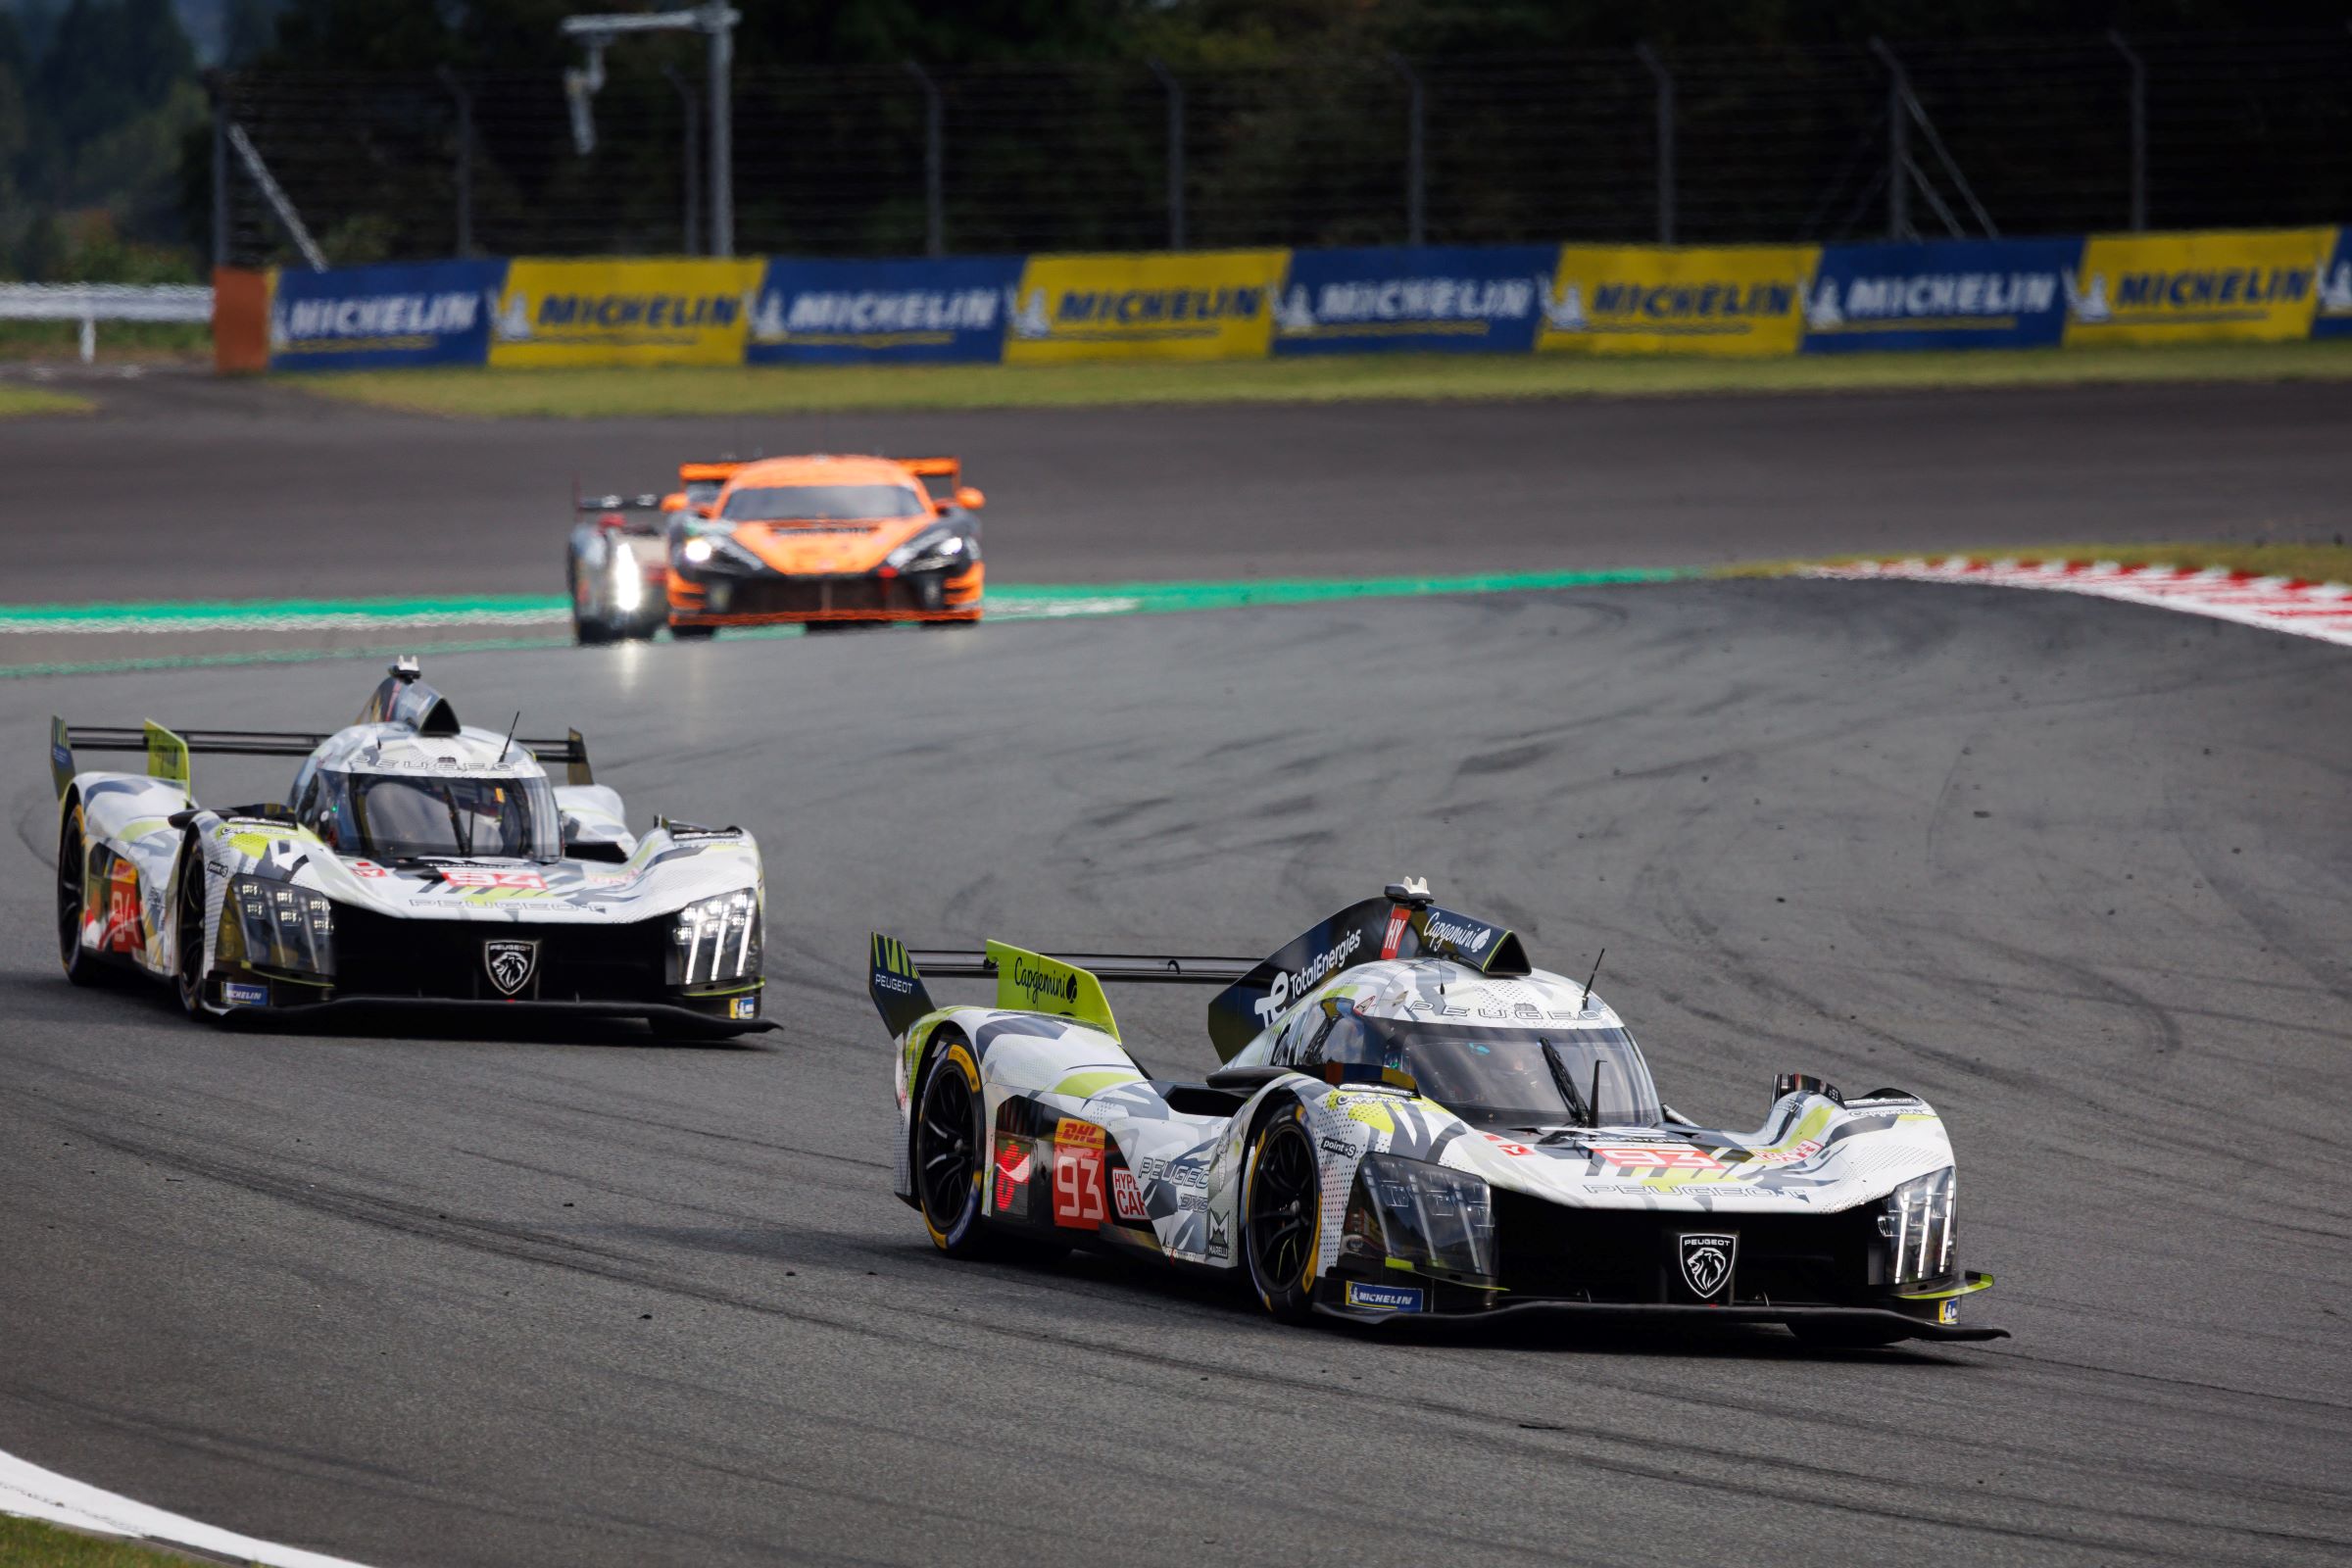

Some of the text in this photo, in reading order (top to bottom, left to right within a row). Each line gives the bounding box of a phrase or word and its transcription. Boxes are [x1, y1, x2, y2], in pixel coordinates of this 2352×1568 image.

[1317, 276, 1536, 321] MICHELIN
[1592, 283, 1792, 318] MICHELIN
[1846, 271, 2059, 317] MICHELIN
[2117, 265, 2314, 304] MICHELIN
[293, 293, 479, 336] MICHELIN
[538, 293, 742, 328] MICHELIN
[787, 287, 998, 332] MICHELIN
[1057, 284, 1265, 324] MICHELIN
[444, 870, 541, 887] 94
[1385, 919, 1404, 951] HY
[1424, 912, 1476, 953] Capgemini
[1014, 956, 1066, 1005] Capgemini
[1290, 929, 1362, 1000] TotalEnergies
[874, 973, 913, 995] PEUGEOT
[1061, 1123, 1098, 1143] DHL
[1139, 1156, 1209, 1189] PEUGEO
[1602, 1150, 1716, 1166] 93
[1057, 1154, 1104, 1220] 93
[1114, 1173, 1139, 1190] HYPE
[1583, 1184, 1808, 1199] PEUGEOT
[1359, 1292, 1412, 1304] MICHELIN
